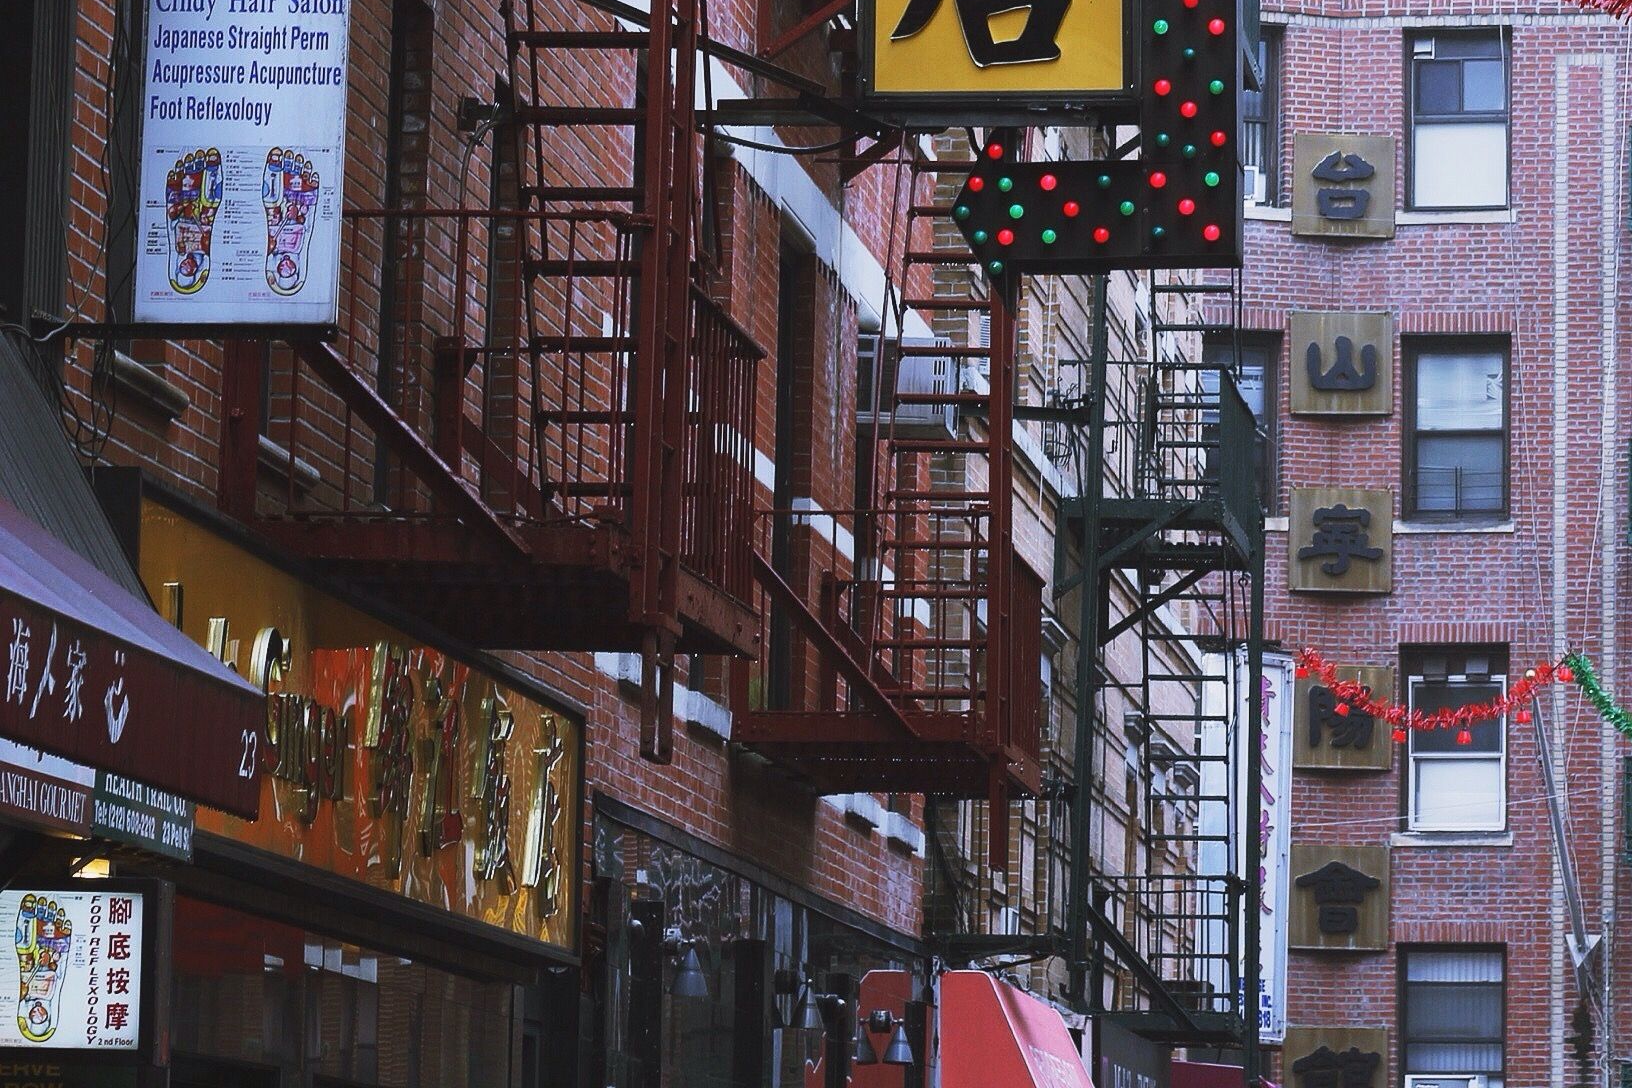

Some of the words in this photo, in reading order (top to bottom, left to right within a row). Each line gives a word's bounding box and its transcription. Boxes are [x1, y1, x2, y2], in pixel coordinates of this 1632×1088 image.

[154, 24, 224, 54] Japanese
[228, 24, 287, 55] Straight
[290, 25, 329, 51] Perm
[152, 58, 245, 89] Acupressure
[249, 60, 342, 90] Acupuncture
[150, 95, 183, 121] Foot
[186, 95, 272, 126] Reflexology
[238, 729, 257, 780] 23
[40, 781, 87, 825] GOURMET
[108, 802, 126, 832] (212)
[89, 895, 102, 934] FOOT
[104, 897, 133, 1031] 腳底按摩
[86, 937, 101, 1045] REFLEXOLOGY
[114, 1037, 134, 1046] Floor
